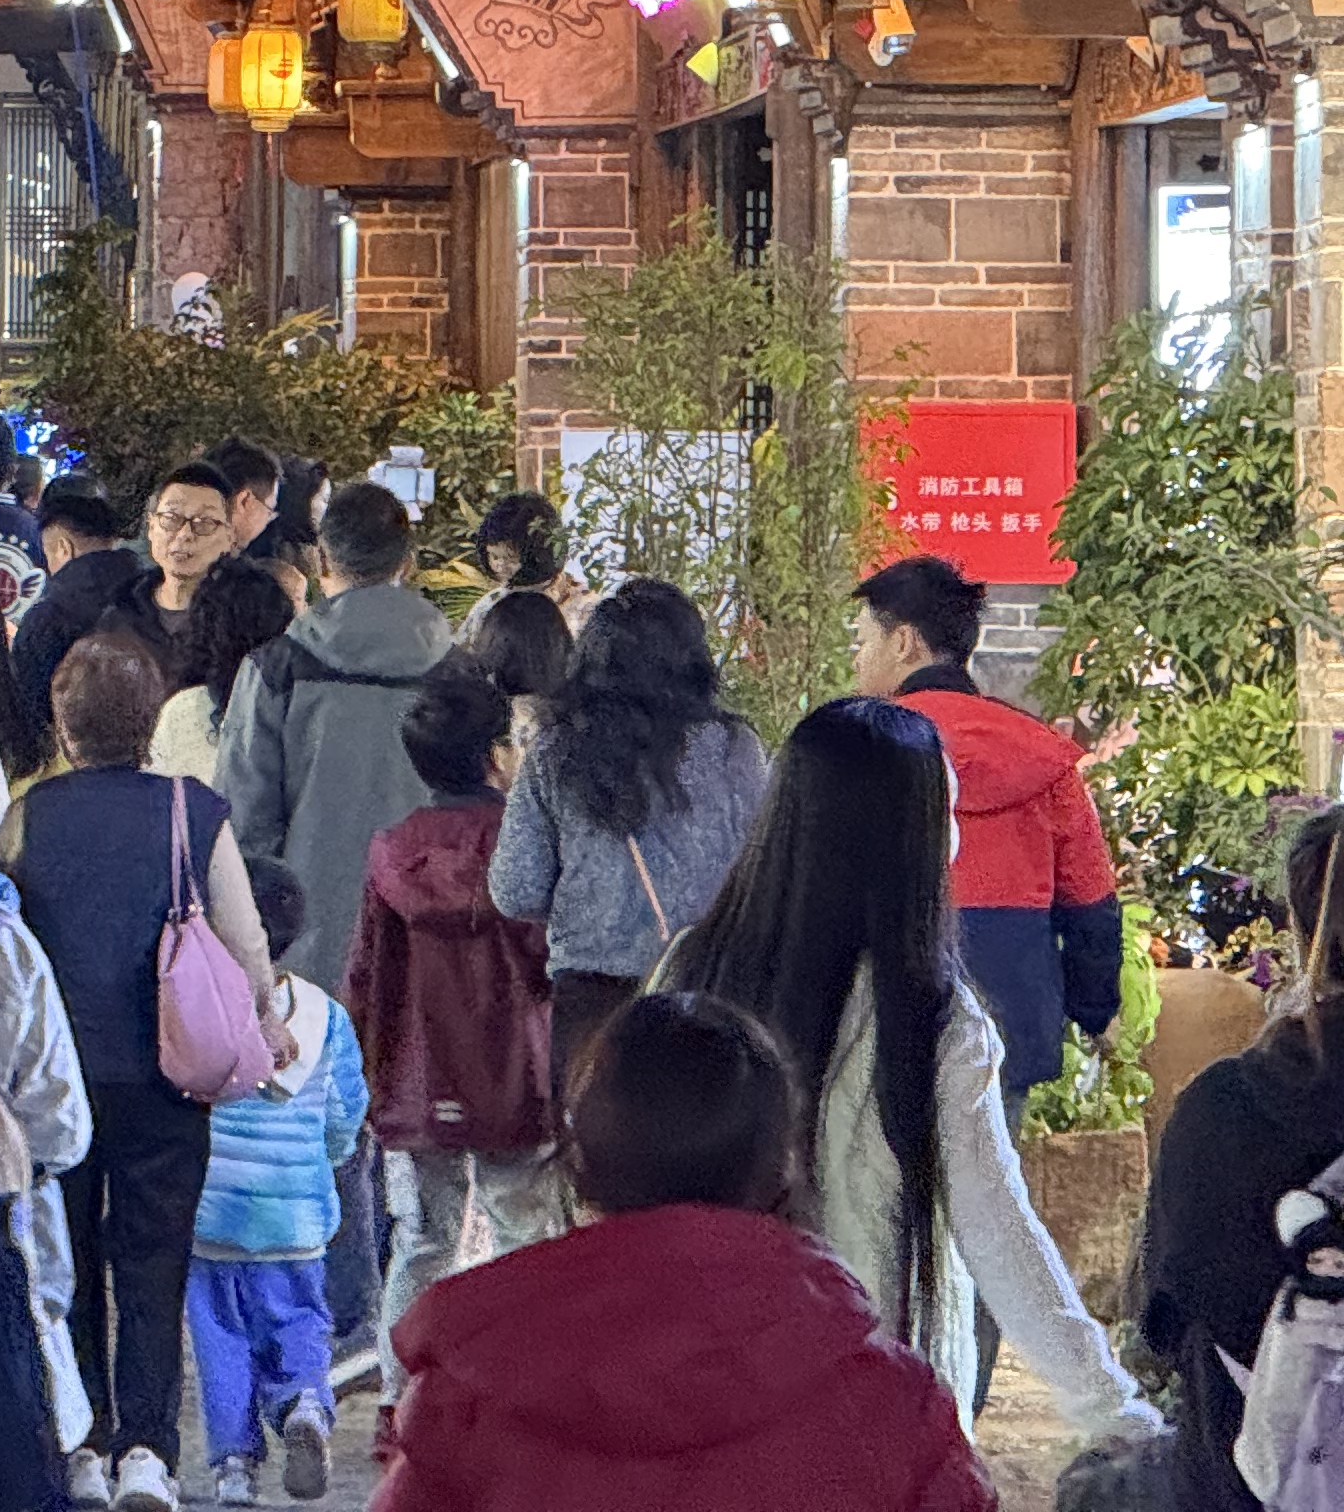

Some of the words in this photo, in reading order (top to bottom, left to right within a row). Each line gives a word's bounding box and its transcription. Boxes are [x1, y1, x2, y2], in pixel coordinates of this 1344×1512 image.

[918, 476, 1023, 497] 消防工具箱
[899, 512, 941, 532] 水带
[951, 512, 992, 532] 枪头
[1000, 512, 1043, 532] 扳手
